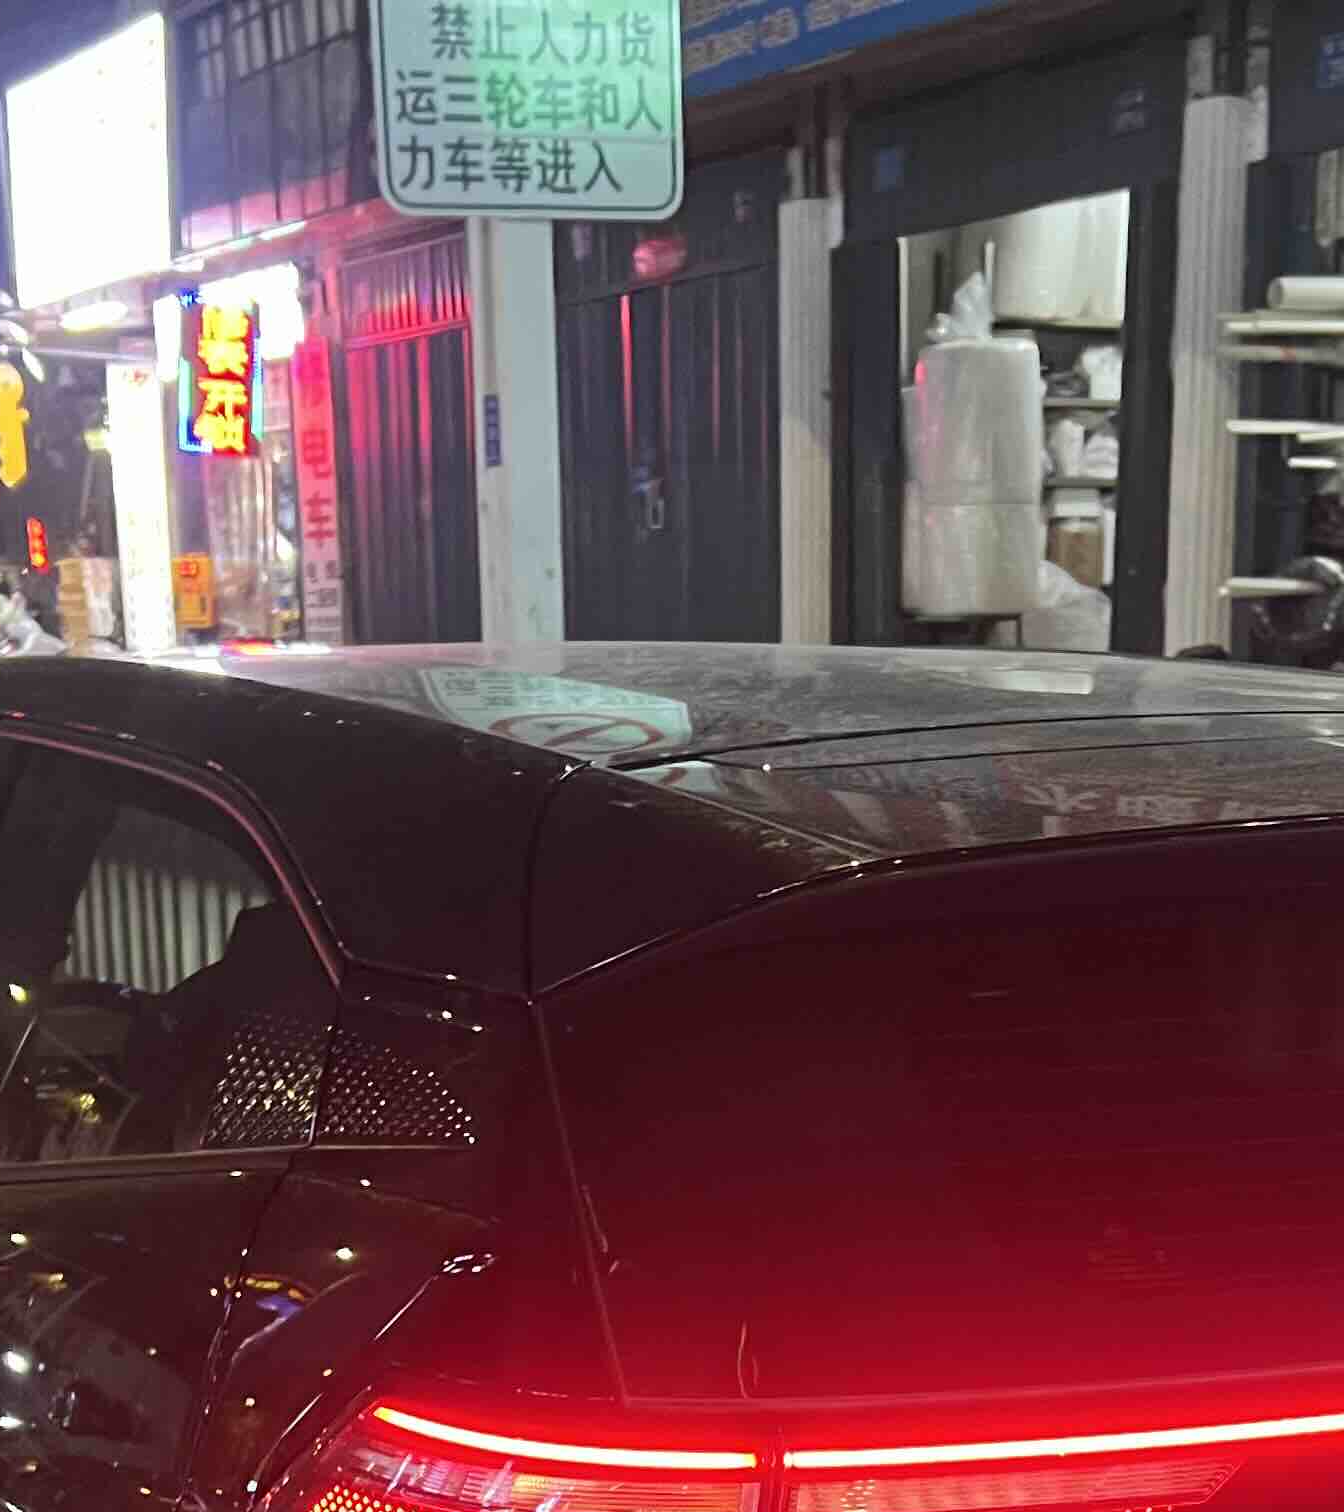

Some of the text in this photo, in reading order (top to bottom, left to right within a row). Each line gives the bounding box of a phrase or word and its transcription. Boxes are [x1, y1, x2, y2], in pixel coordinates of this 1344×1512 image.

[431, 5, 656, 66] 禁止人力货
[395, 69, 663, 132] 运三轮车和人
[397, 136, 623, 194] 力车等进入
